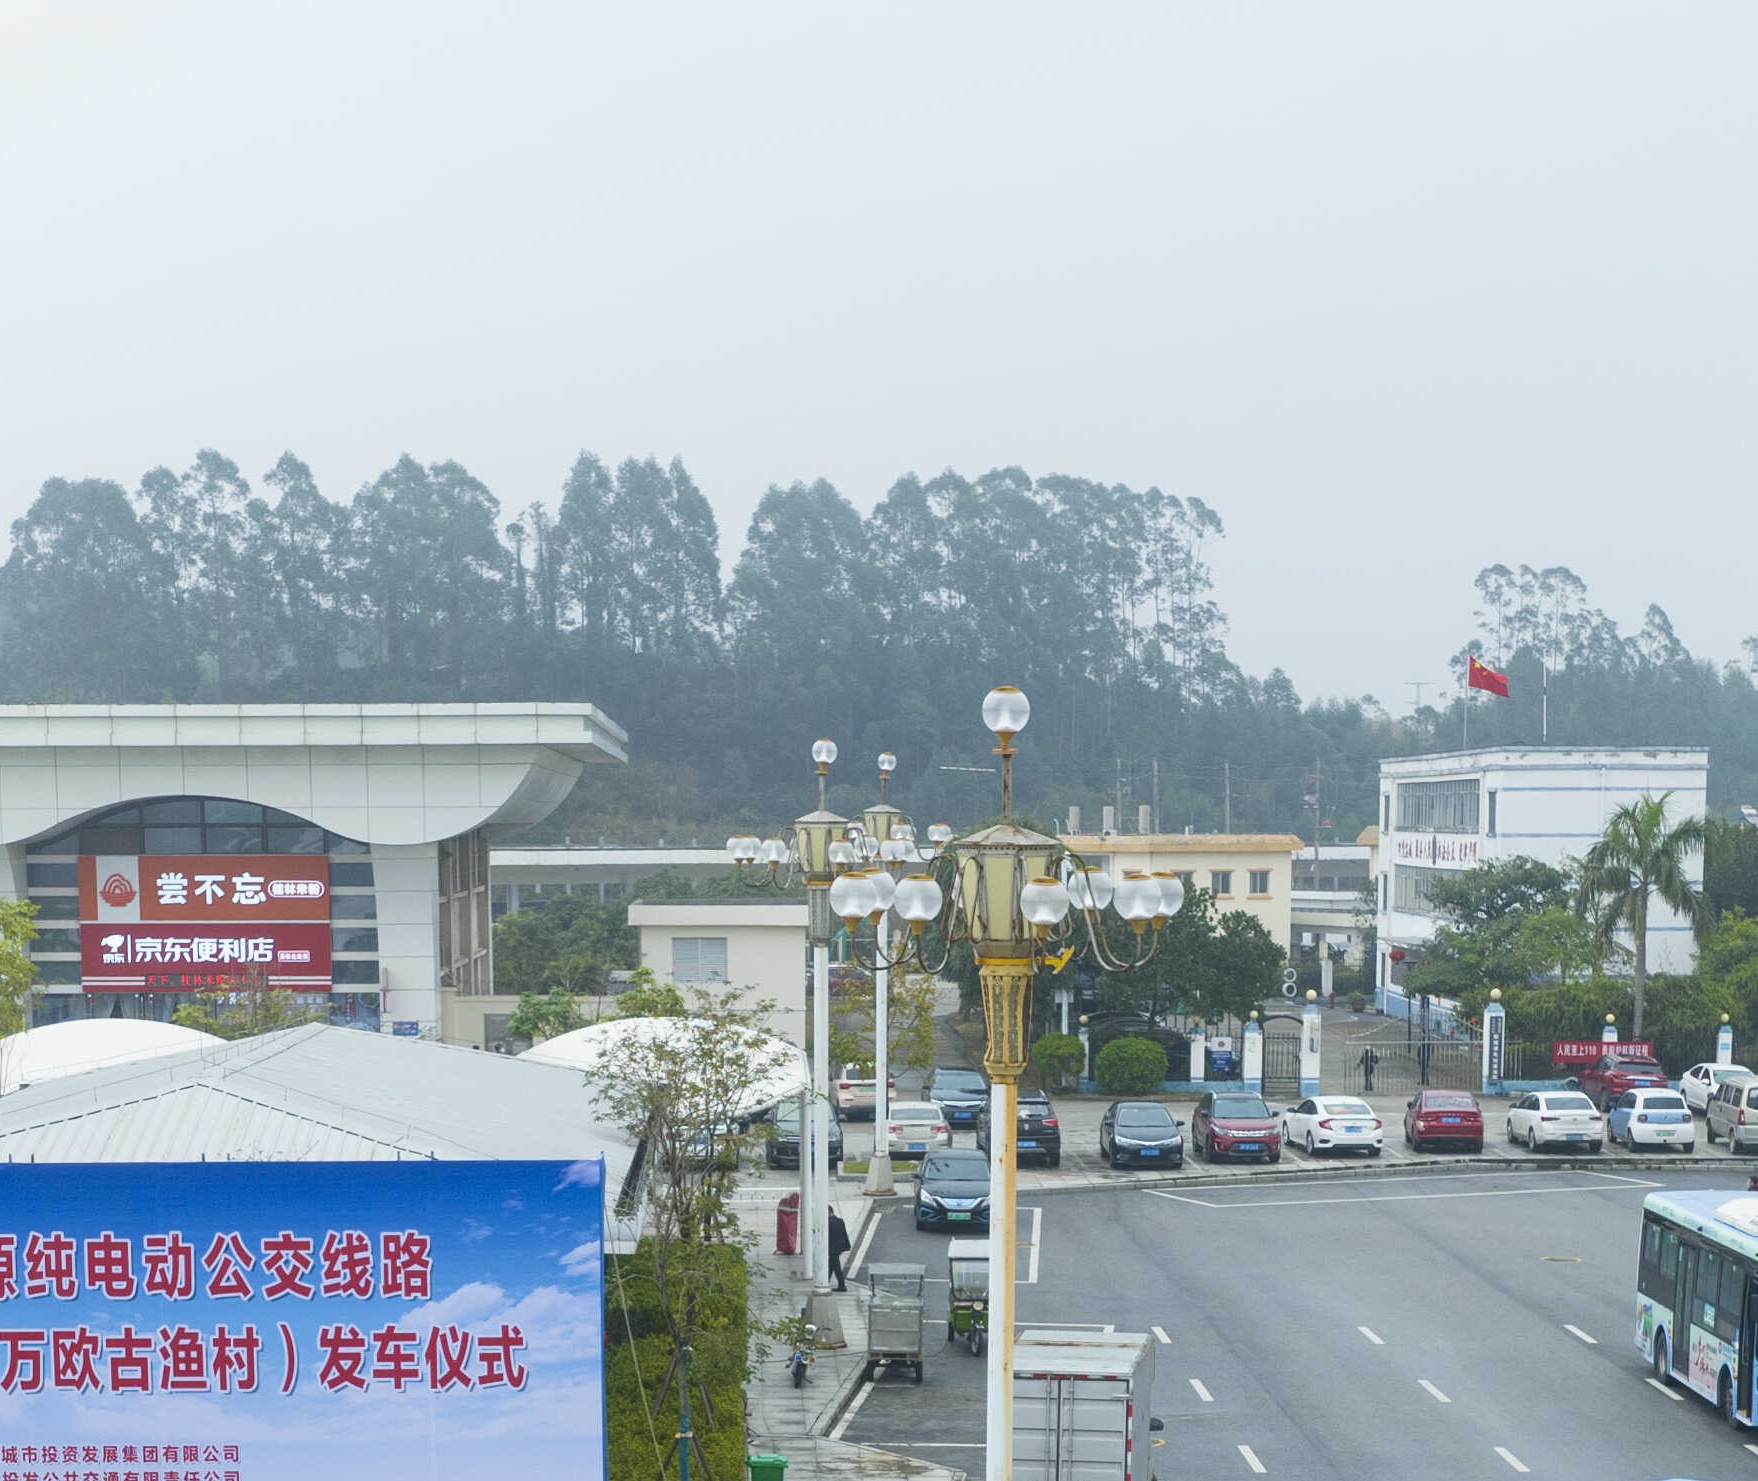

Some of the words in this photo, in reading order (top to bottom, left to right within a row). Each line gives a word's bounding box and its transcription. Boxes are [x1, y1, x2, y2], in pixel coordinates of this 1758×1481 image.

[156, 872, 267, 905] 尝不忘
[135, 936, 276, 964] 京东便利店
